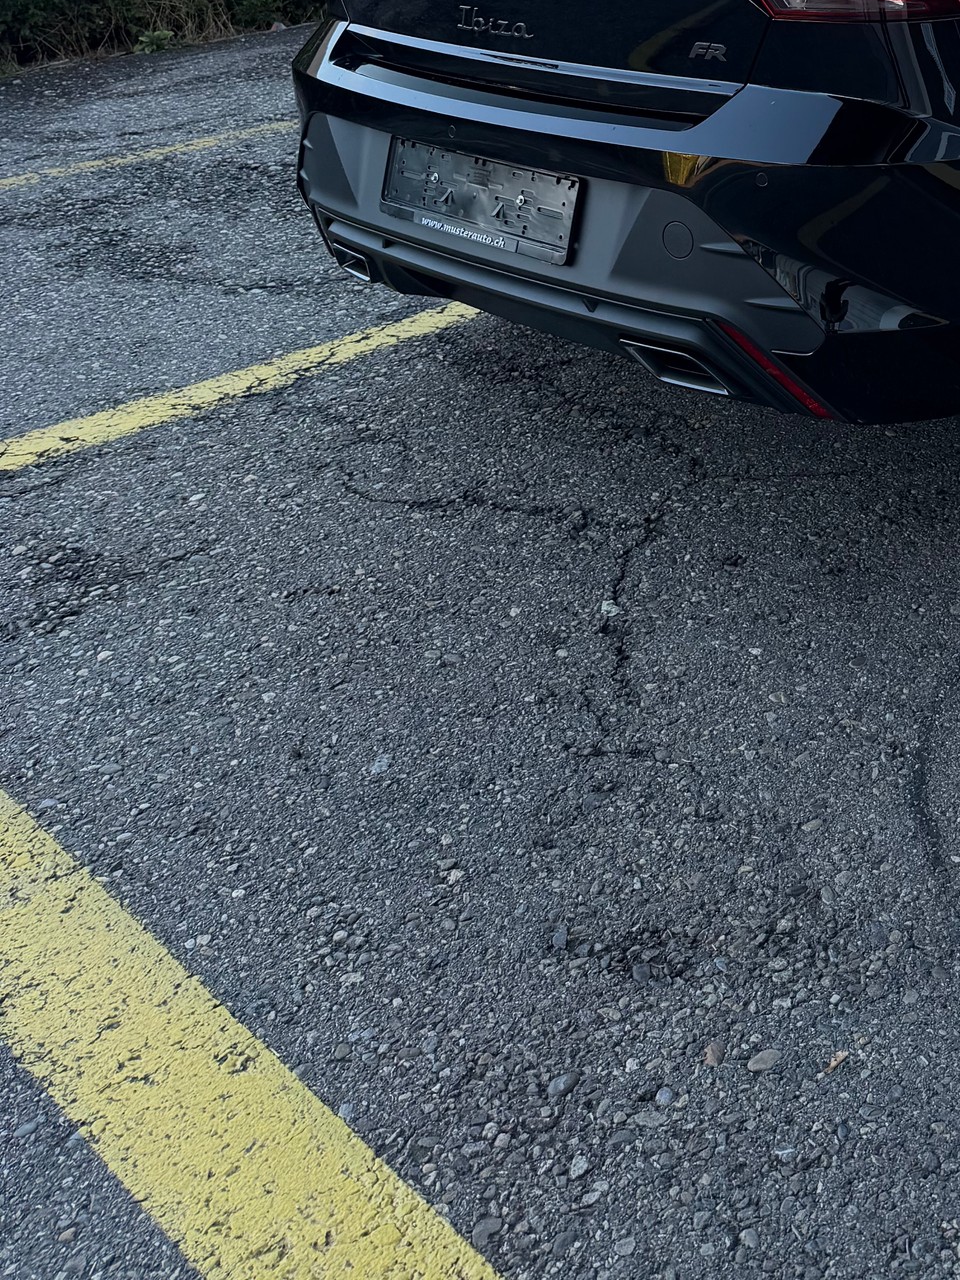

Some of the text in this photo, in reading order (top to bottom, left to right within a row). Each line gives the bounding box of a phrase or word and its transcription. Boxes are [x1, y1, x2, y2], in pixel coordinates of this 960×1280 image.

[456, 5, 534, 38] Ibiza
[688, 41, 728, 62] FR
[421, 216, 506, 249] www.musterauto.ch
